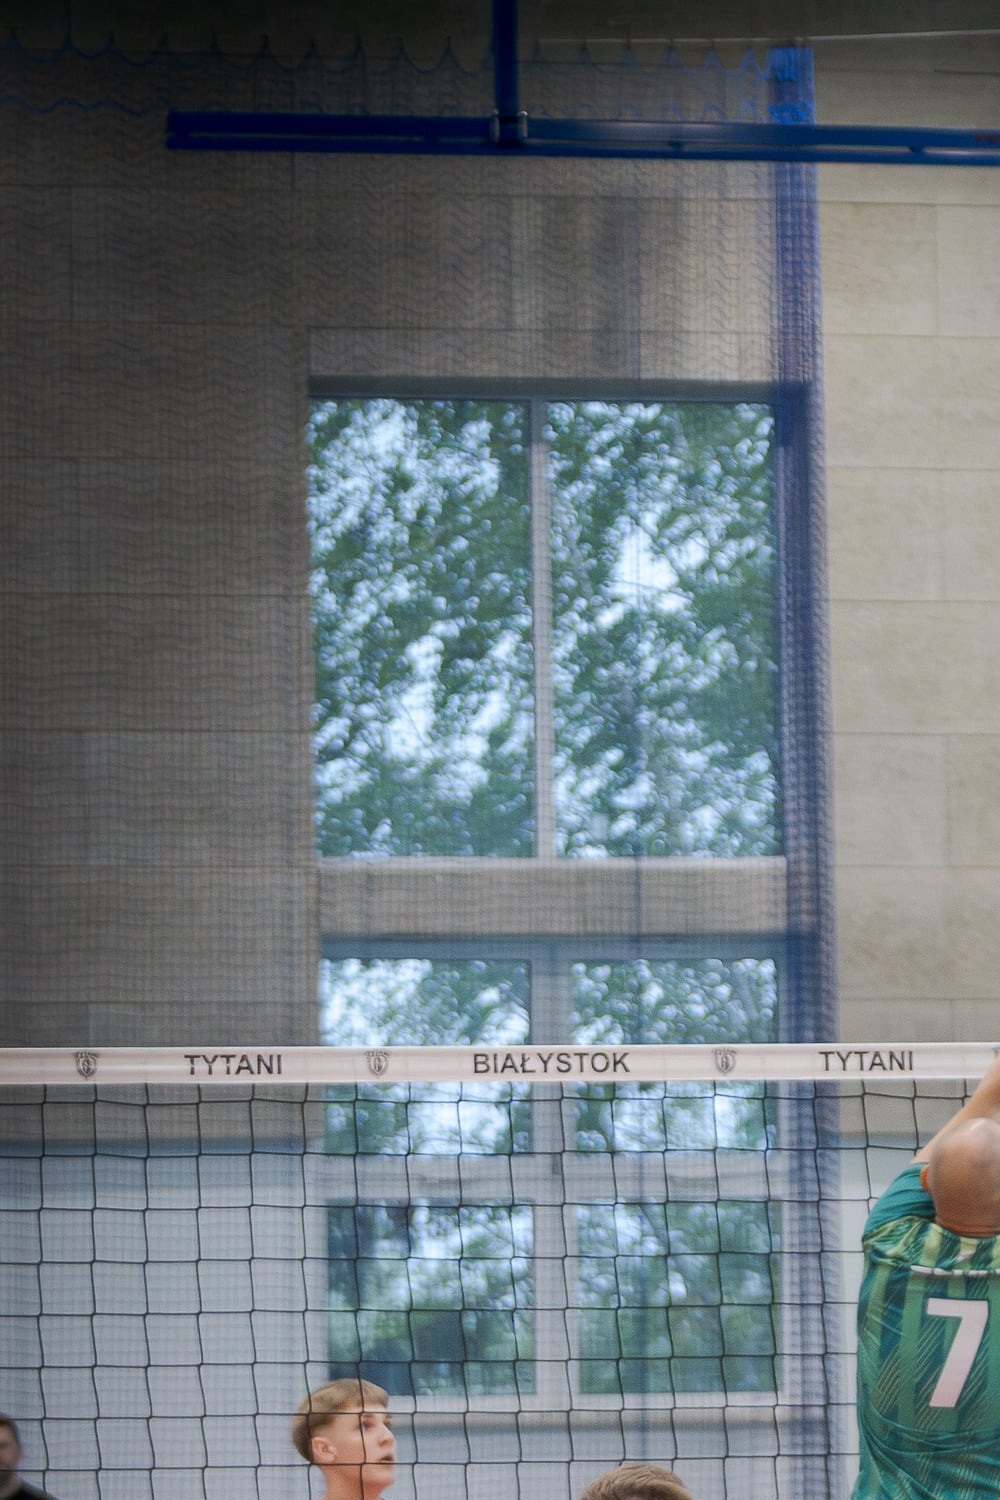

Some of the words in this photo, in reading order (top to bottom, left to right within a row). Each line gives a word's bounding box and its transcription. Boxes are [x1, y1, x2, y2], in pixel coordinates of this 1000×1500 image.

[184, 1053, 283, 1076] TYTANI
[473, 1051, 631, 1074] BIAŁYSTOK
[819, 1050, 914, 1072] TYTANI
[926, 1297, 989, 1408] 7
